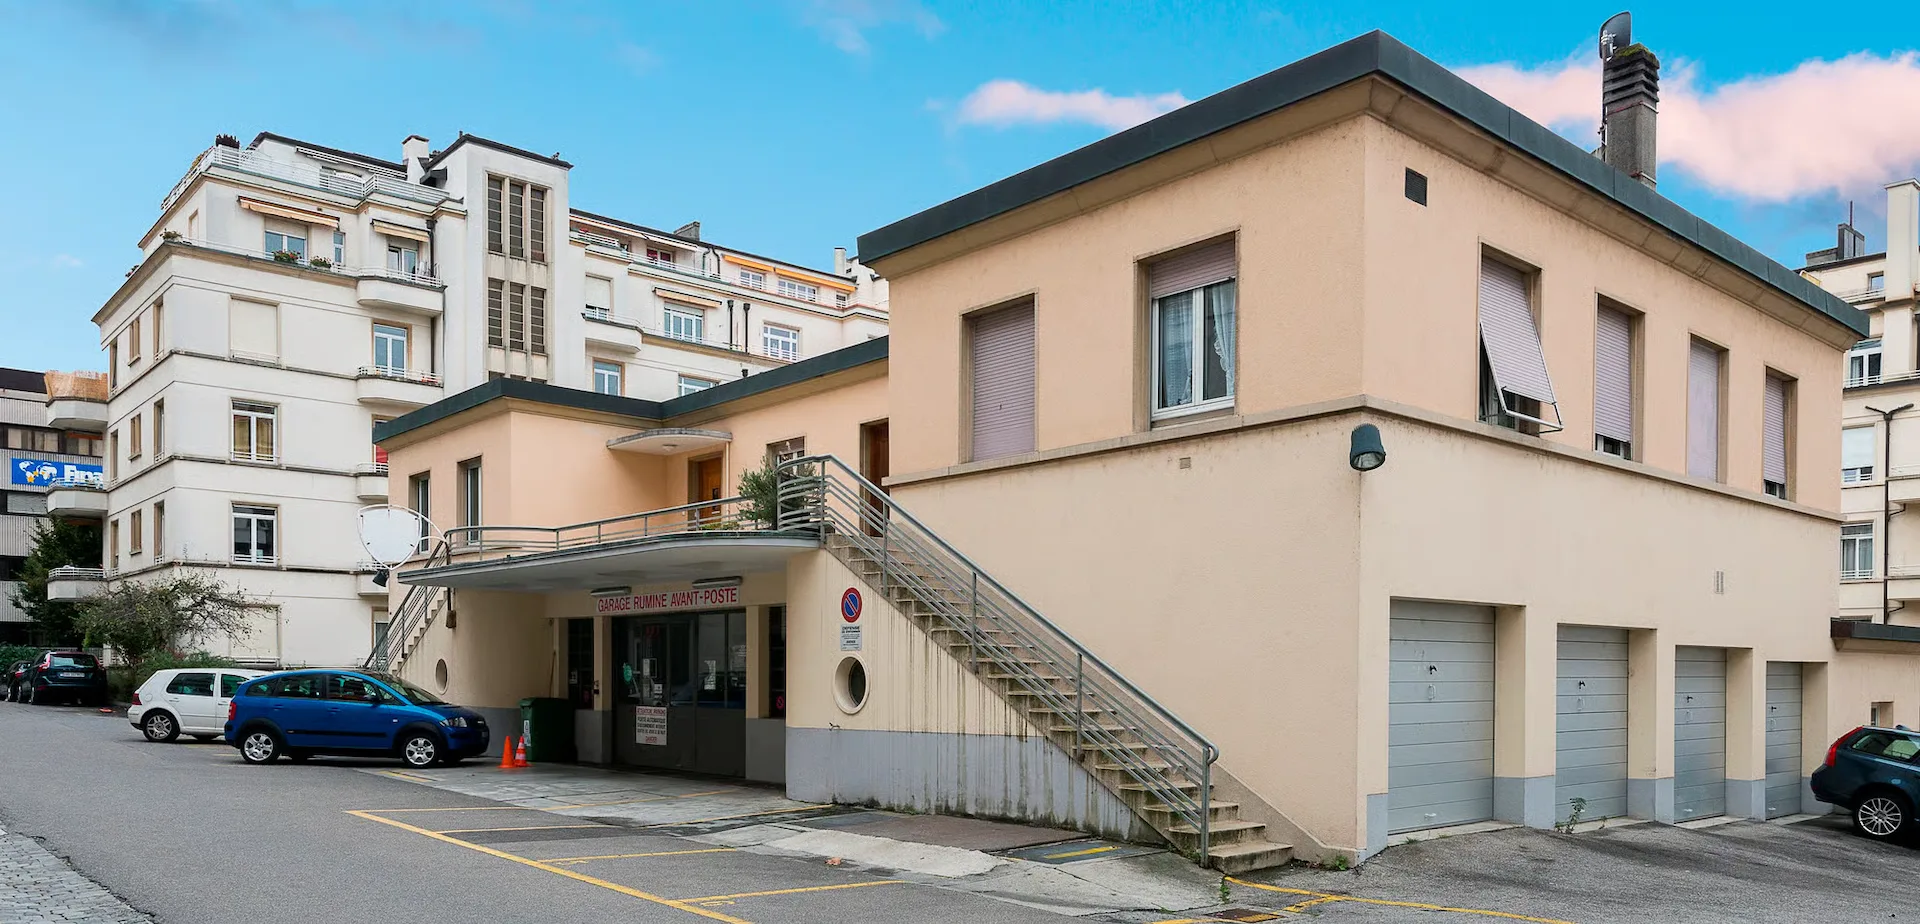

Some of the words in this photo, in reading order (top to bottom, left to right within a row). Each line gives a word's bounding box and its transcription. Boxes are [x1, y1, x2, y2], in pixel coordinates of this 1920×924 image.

[598, 597, 631, 612] GARAGE
[633, 593, 667, 610] RUMINE
[670, 587, 737, 607] AVANT-POSTE
